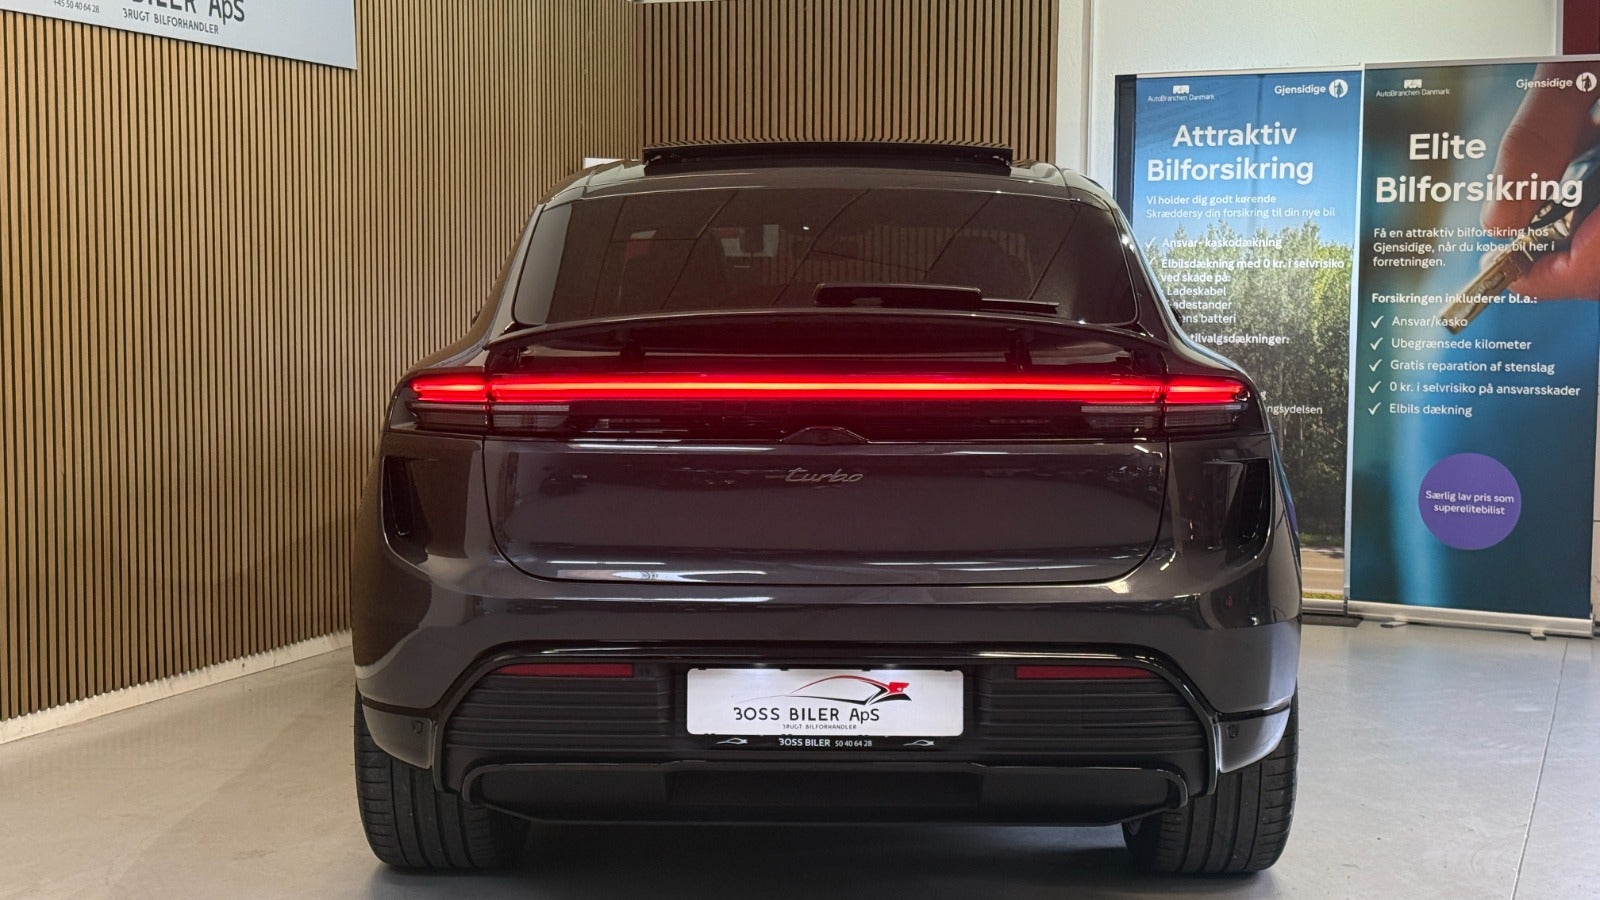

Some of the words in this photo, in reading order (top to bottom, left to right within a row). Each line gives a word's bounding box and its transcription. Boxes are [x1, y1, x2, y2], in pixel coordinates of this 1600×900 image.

[75, 2, 82, 10] 40
[208, 0, 245, 25] ApS
[154, 14, 219, 34] BILFORHANDLER
[1515, 78, 1573, 90] Gjensidige
[1274, 85, 1326, 96] Gjensidige
[1421, 88, 1450, 96] Danmark
[1172, 121, 1297, 147] Attraktiv
[1409, 132, 1487, 160] Elite
[1147, 156, 1314, 185] Bilforsikring
[1376, 172, 1583, 208] Bilforsikring
[1146, 195, 1156, 205] Vi
[1158, 195, 1190, 205] holder
[1192, 195, 1207, 206] dig
[1209, 195, 1233, 206] godt
[1235, 194, 1277, 204] kørende
[1146, 209, 1203, 219] Skræddersy
[1205, 209, 1221, 218] din
[1223, 208, 1269, 219] forsikring
[1271, 208, 1282, 217] til
[1284, 208, 1300, 217] din
[1302, 209, 1321, 219] nye
[1323, 208, 1336, 217] bil
[1373, 227, 1387, 238] Få
[1389, 230, 1403, 238] en
[1405, 228, 1454, 238] attraktiv
[1457, 227, 1525, 239] bilforsikring
[1527, 227, 1549, 237] hos
[1205, 237, 1282, 249] kaskodækning
[1373, 242, 1435, 254] Gjensidige,
[1438, 241, 1456, 252] når
[1458, 242, 1474, 252] du
[1476, 242, 1509, 252] køber
[1511, 241, 1526, 252] bil
[1529, 241, 1549, 252] her
[1161, 259, 1235, 271] Elbilsdækning
[1237, 259, 1261, 269] med
[1263, 259, 1271, 268] 0
[1272, 259, 1286, 268] kr.
[1293, 258, 1345, 269] selvrisiko
[1372, 256, 1446, 268] forretningen.
[1160, 273, 1180, 282] ved
[1182, 272, 1213, 282] skade
[1214, 272, 1232, 284] på:
[1167, 286, 1227, 296] Ladeskabel
[1170, 300, 1232, 310] adestander
[1371, 293, 1443, 305] Forsikringen
[1445, 293, 1507, 304] inkluderer
[1508, 293, 1538, 304] bl.a.:
[1200, 313, 1237, 323] batteri
[1391, 316, 1468, 327] Ansvar/kasko
[1391, 338, 1473, 350] Ubegrænsede
[1474, 339, 1532, 350] kilometer
[1390, 360, 1425, 371] Gratis
[1427, 361, 1487, 373] reparation
[1489, 362, 1501, 372] af
[1504, 362, 1555, 375] stenslag
[1389, 382, 1397, 392] 0
[1399, 383, 1414, 392] kr.
[1416, 383, 1420, 393] i
[1422, 383, 1476, 394] selvrisiko
[1479, 383, 1494, 396] på
[1496, 385, 1580, 396] ansvarsskader
[1389, 403, 1420, 414] Elbils
[1422, 404, 1473, 418] dækning
[785, 467, 863, 482] turbo
[1425, 490, 1456, 502] Særlig
[1458, 492, 1471, 501] lav
[1474, 493, 1492, 503] pris
[1494, 495, 1514, 503] som
[1433, 503, 1505, 515] superelitebilist
[790, 707, 839, 722] BILER
[849, 708, 880, 724] ApS
[805, 738, 831, 747] BILER
